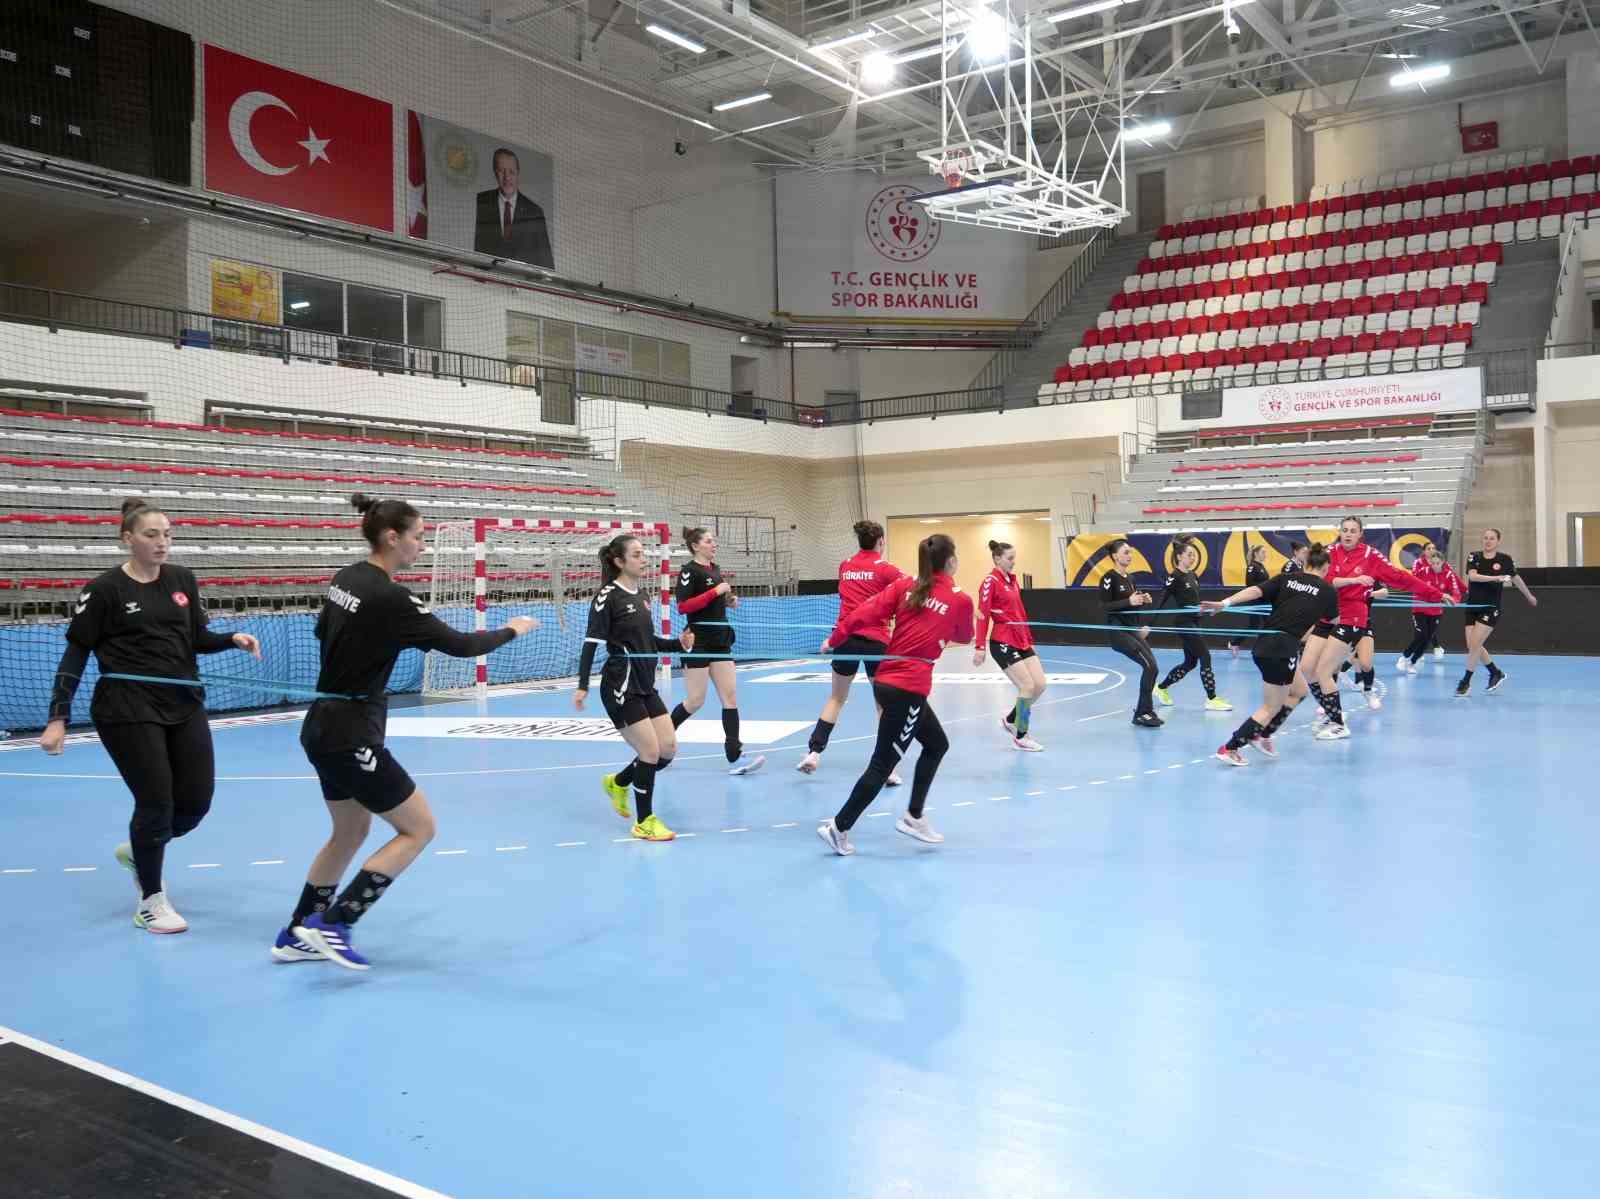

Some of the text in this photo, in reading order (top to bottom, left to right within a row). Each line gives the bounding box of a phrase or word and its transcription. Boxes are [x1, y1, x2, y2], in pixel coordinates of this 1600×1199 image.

[830, 270, 977, 291] T.C. GENÇLİK VE
[831, 292, 978, 309] SPOR BAKANLIĞI
[1338, 399, 1352, 408] VE
[1354, 397, 1381, 408] SPOR
[842, 571, 874, 581] TÜRKİYE
[904, 592, 949, 615] TKİYE
